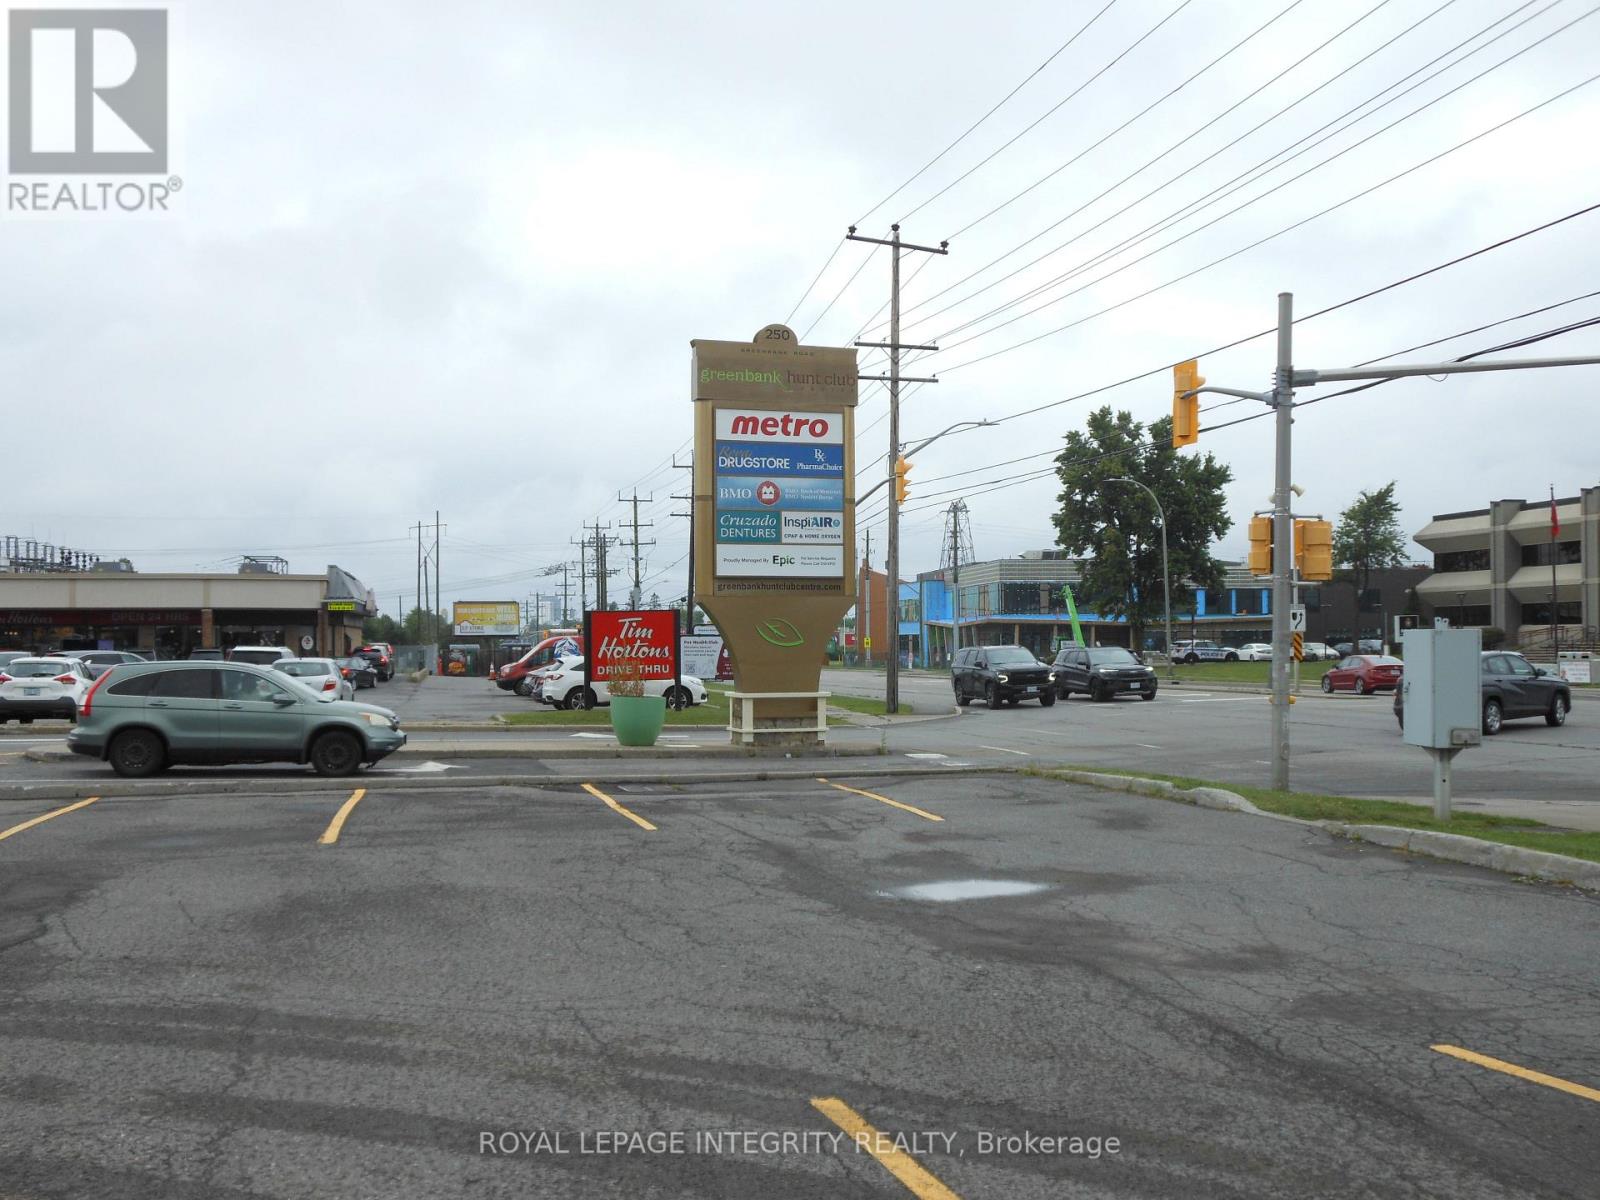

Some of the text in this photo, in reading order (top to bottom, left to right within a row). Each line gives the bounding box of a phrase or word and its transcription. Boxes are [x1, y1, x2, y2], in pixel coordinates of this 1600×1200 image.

[766, 329, 790, 341] 250
[700, 368, 856, 387] greenbank hunt club
[731, 414, 829, 438] metro
[718, 456, 790, 470] DRUGSTORE
[796, 462, 843, 472] PharmaChoice
[720, 488, 752, 499] BMO
[720, 514, 777, 526] Cruzado
[720, 528, 776, 538] DENTURES
[772, 555, 795, 567] Epic
[718, 582, 841, 592] greenbankhuntclubcentre.com
[618, 617, 654, 639] Tim
[597, 636, 670, 660] Hortons
[597, 664, 670, 675] DRIVE THRU
